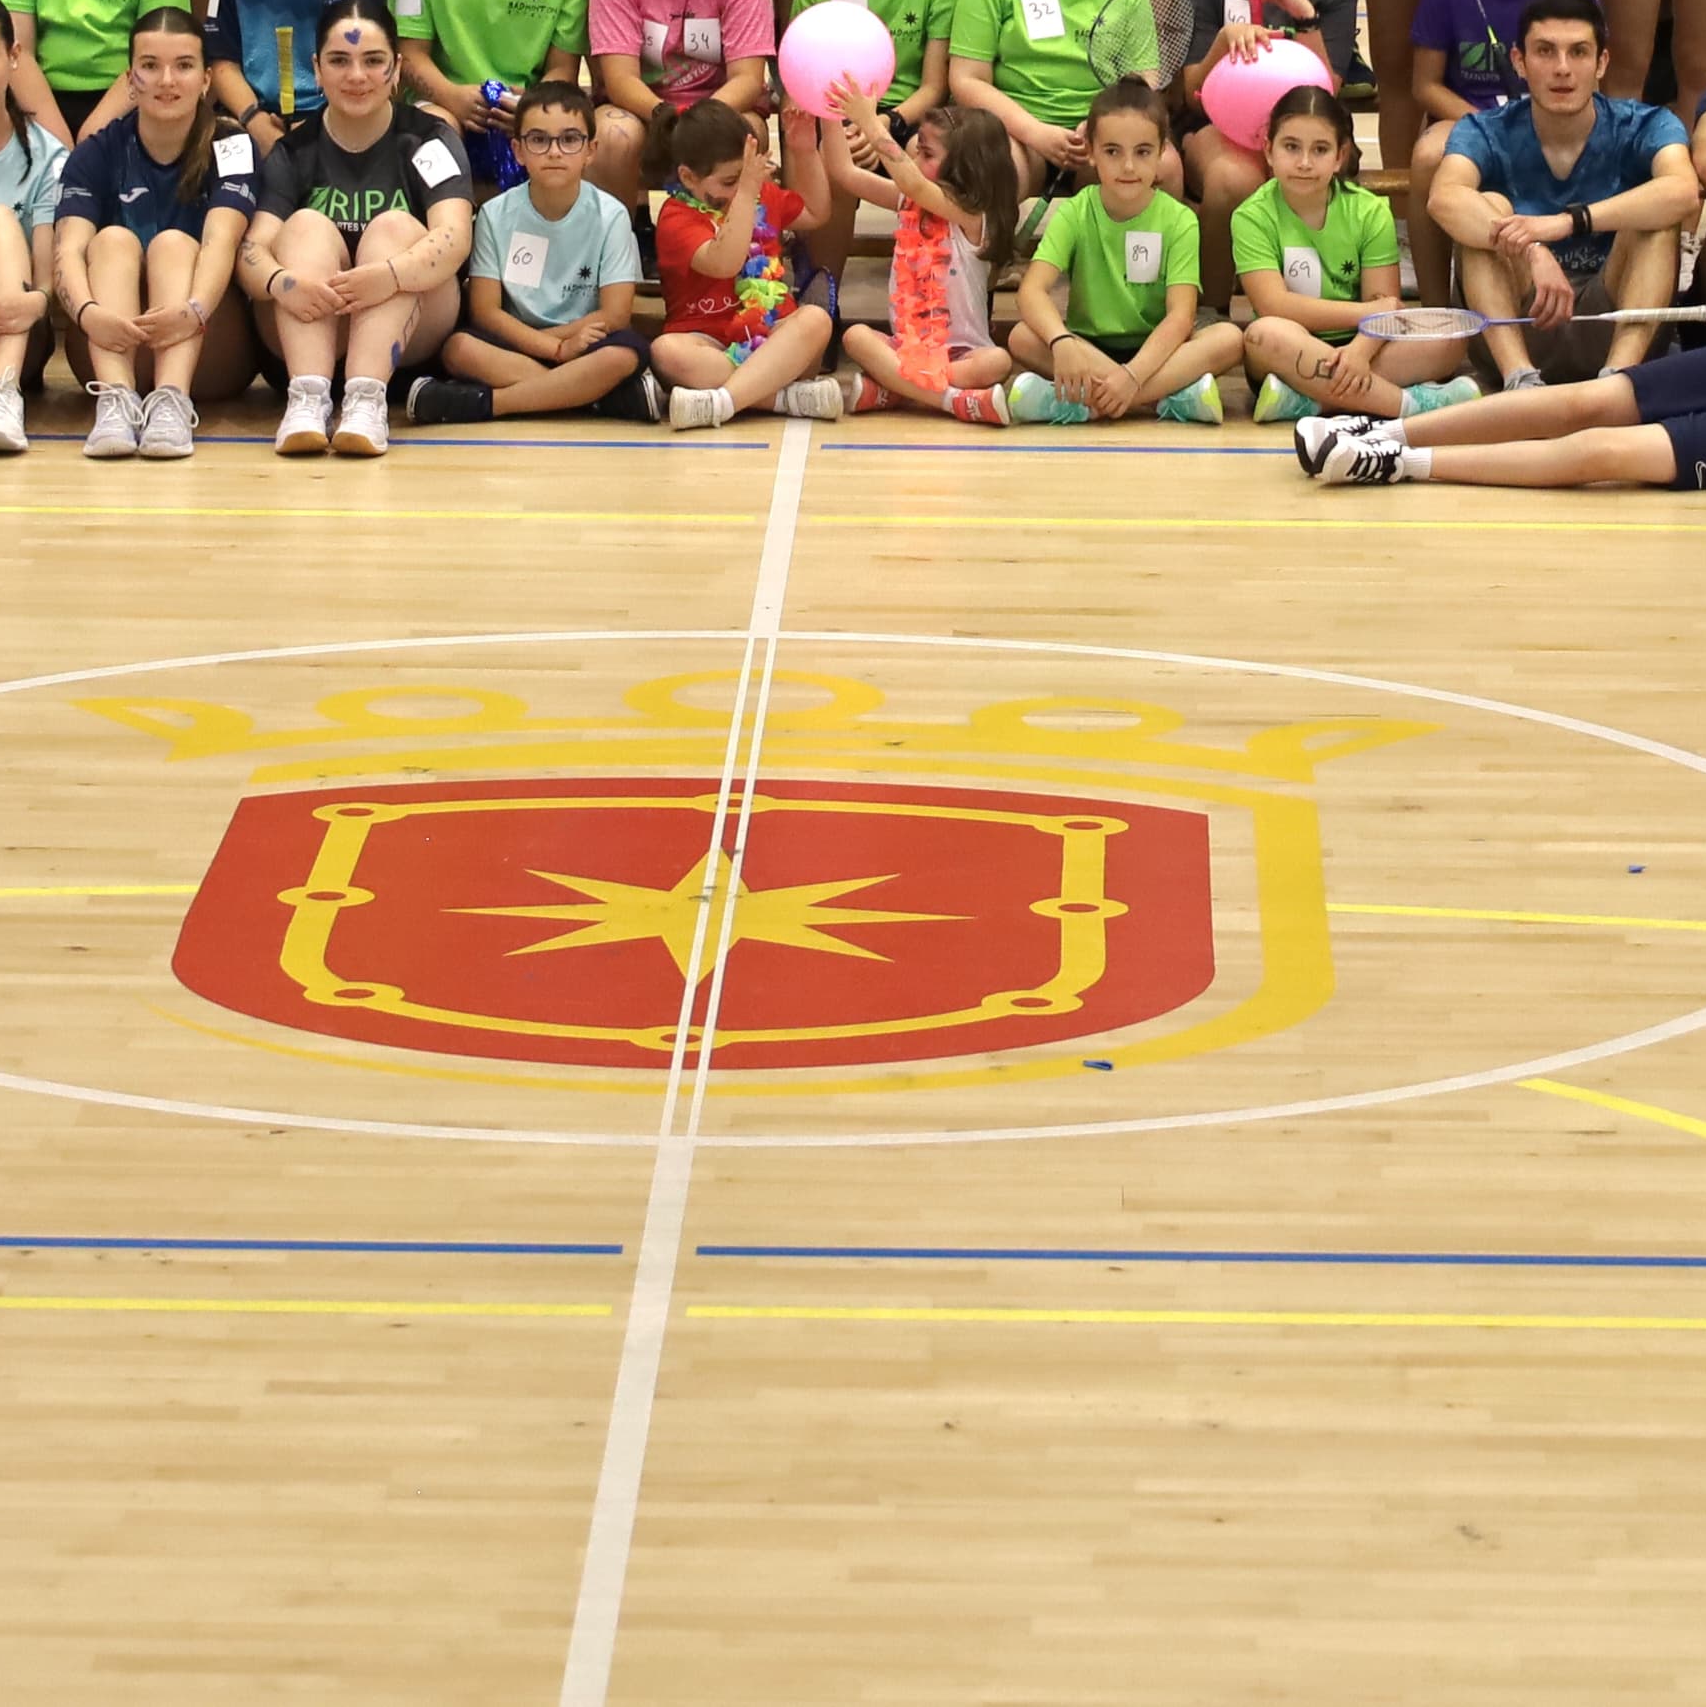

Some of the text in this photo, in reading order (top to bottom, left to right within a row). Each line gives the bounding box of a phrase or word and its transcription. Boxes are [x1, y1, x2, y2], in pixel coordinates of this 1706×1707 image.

[1028, 2, 1055, 20] 32
[689, 32, 710, 52] 34
[329, 188, 411, 221] RIPA
[512, 246, 534, 266] 60
[1132, 245, 1149, 263] 89
[1288, 260, 1311, 279] 69
